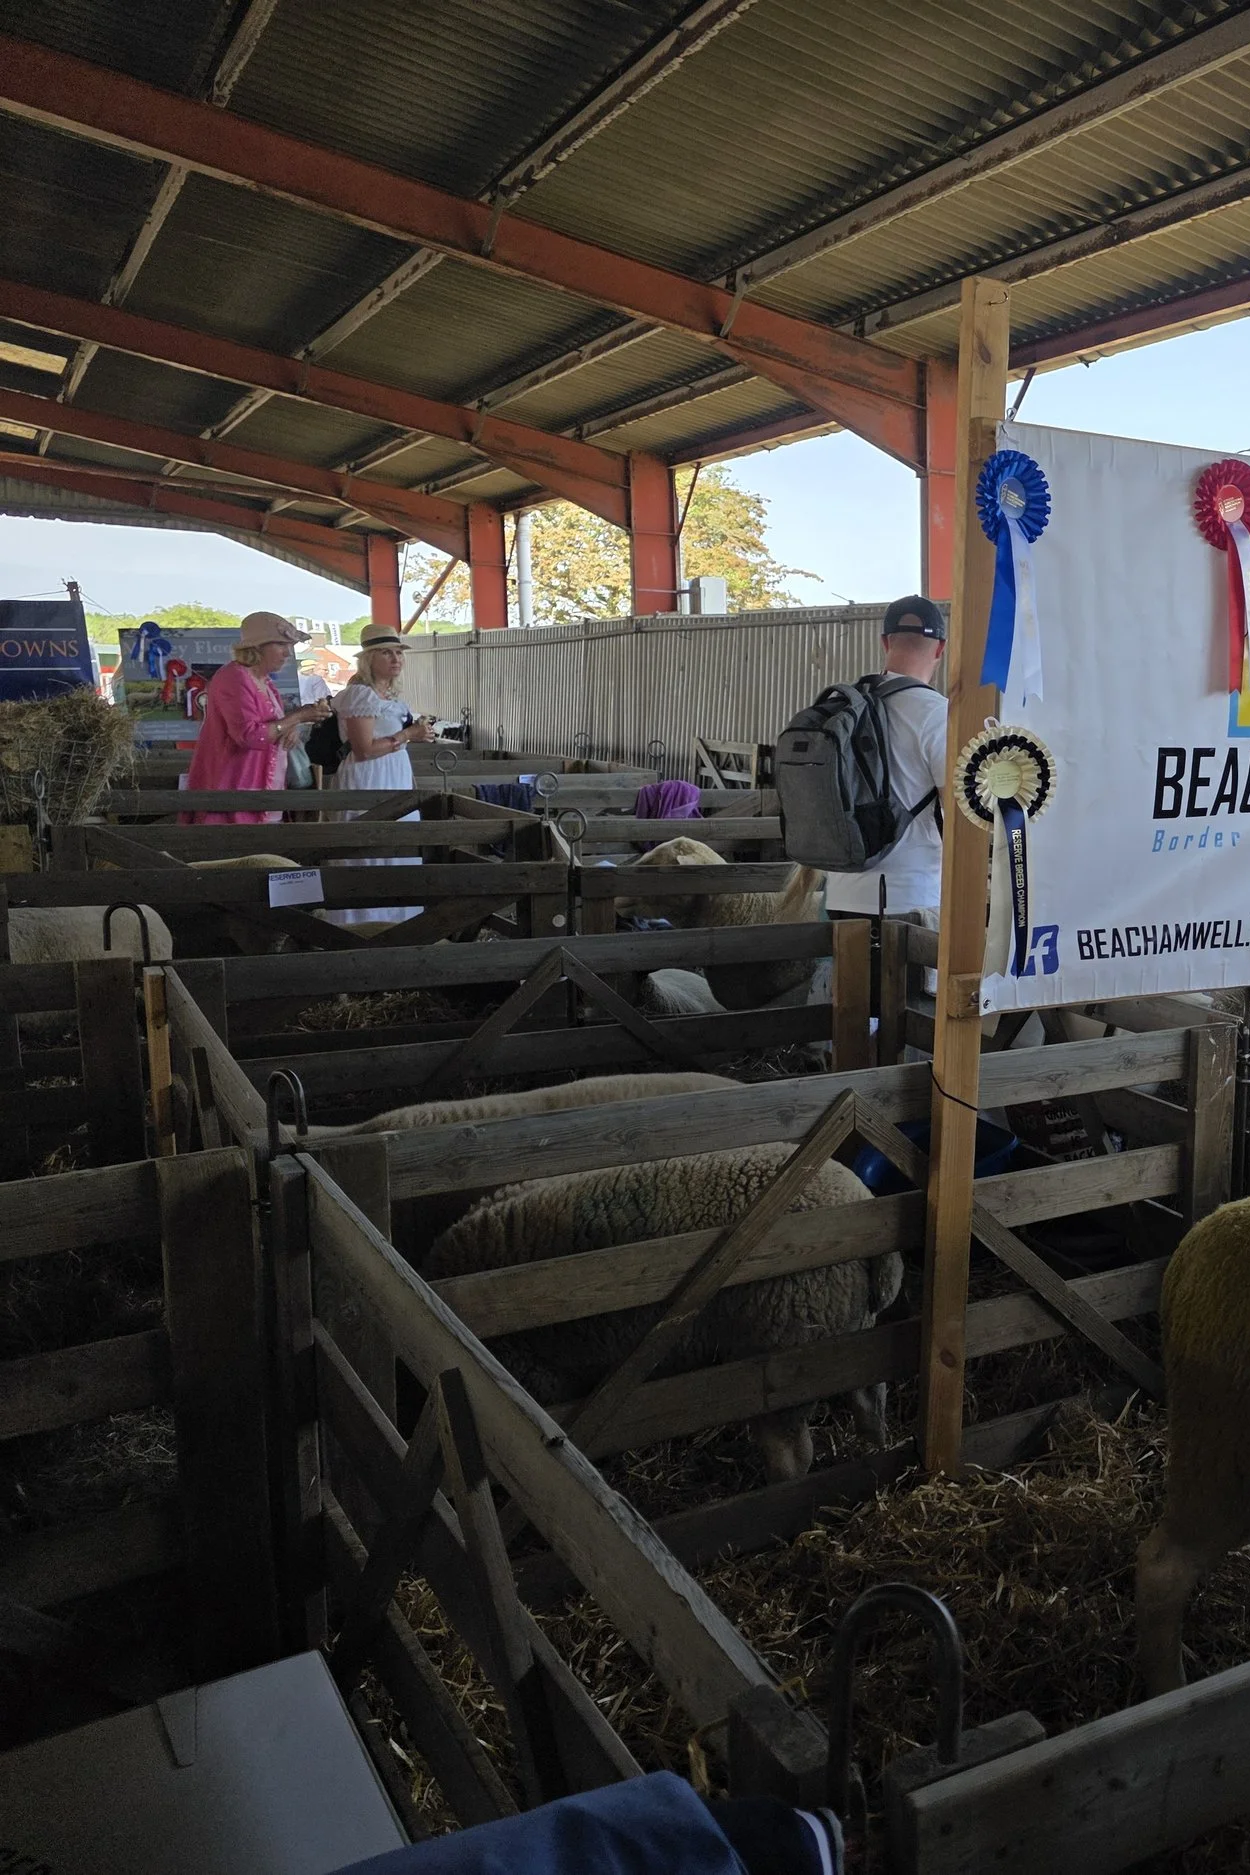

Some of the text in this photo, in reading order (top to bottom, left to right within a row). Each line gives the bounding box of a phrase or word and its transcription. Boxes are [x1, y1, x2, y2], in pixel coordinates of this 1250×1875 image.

[0, 639, 79, 657] OWNS
[1152, 825, 1240, 852] Border
[270, 870, 317, 881] ESERVED FOR
[1011, 828, 1026, 928] RESERVE BREED CHAMPION
